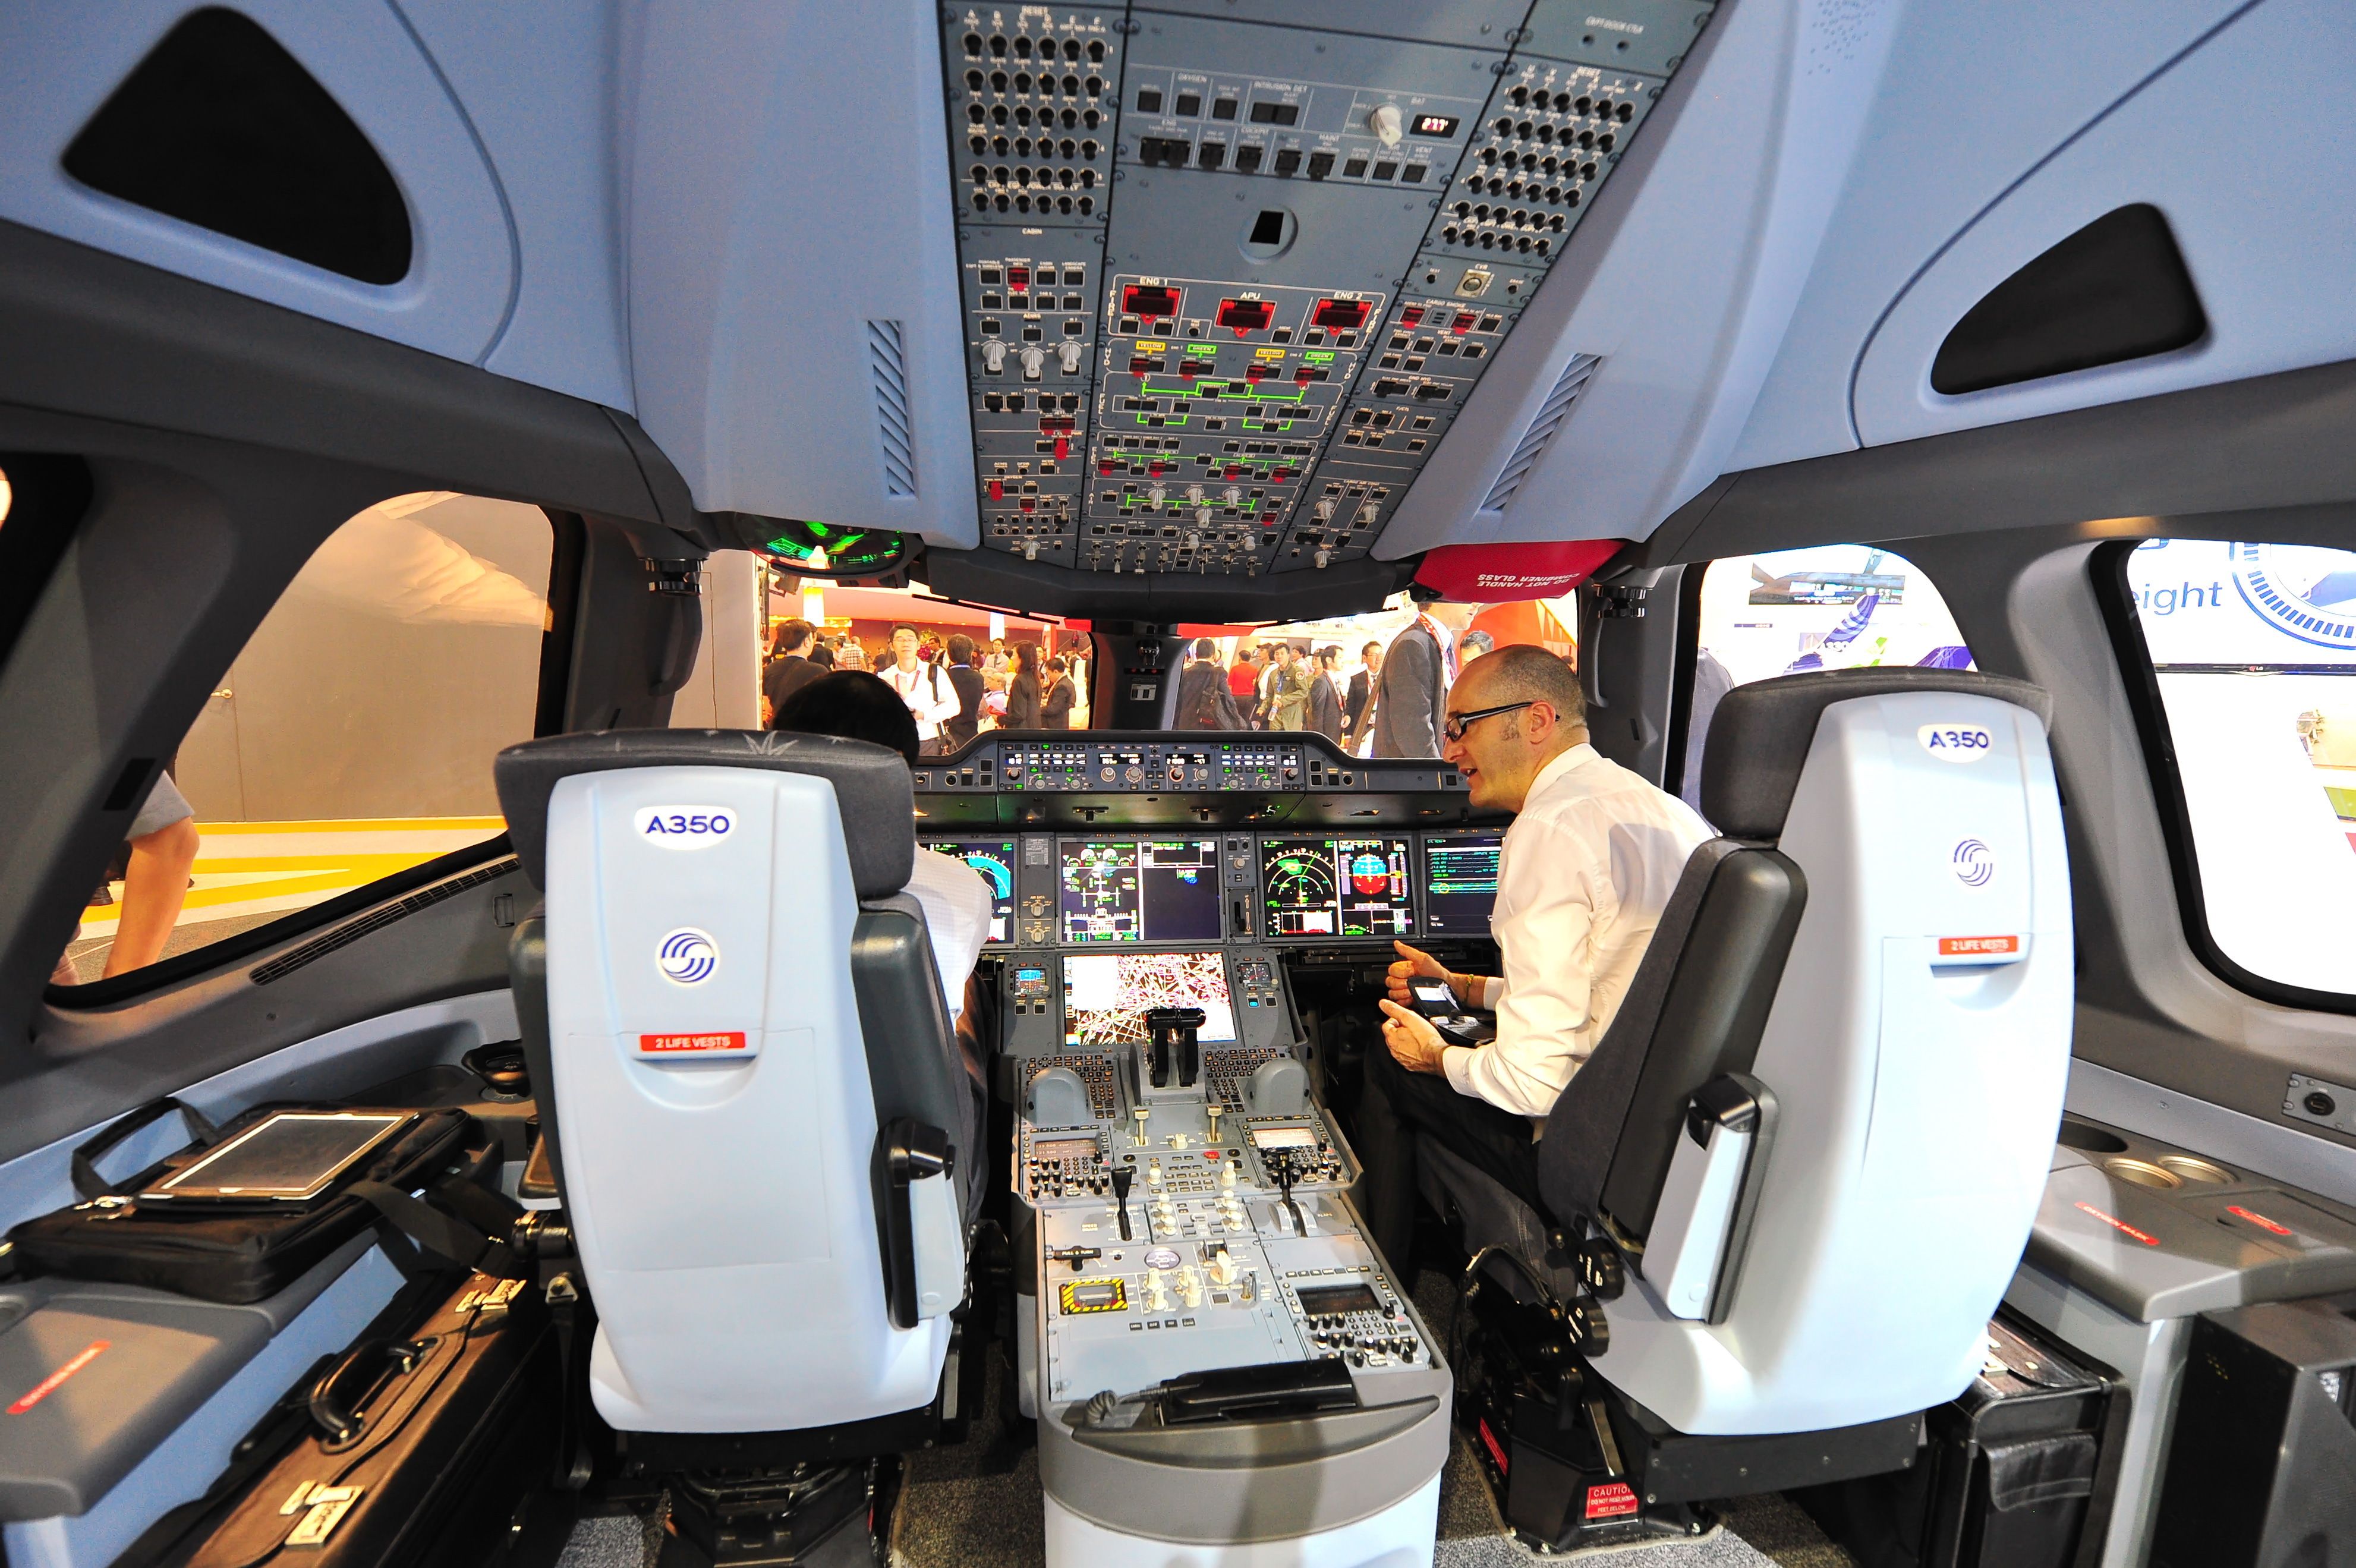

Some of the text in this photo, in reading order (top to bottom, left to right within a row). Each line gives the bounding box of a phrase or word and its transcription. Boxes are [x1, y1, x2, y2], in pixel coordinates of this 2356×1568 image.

[1140, 277, 1160, 285] ENG
[1107, 290, 1117, 316] FIRE
[1240, 291, 1261, 300] APU
[1343, 362, 1357, 379] HYD
[1304, 456, 1316, 474] ELEC
[1520, 573, 1580, 583] COMBINER
[1929, 731, 1989, 749] A350
[646, 815, 730, 834] A350
[1951, 939, 2009, 951] 2 LIFE VESTS
[655, 1036, 731, 1049] 2 LIFE VESTS
[2083, 1206, 2149, 1241] OXYGEN MASK
